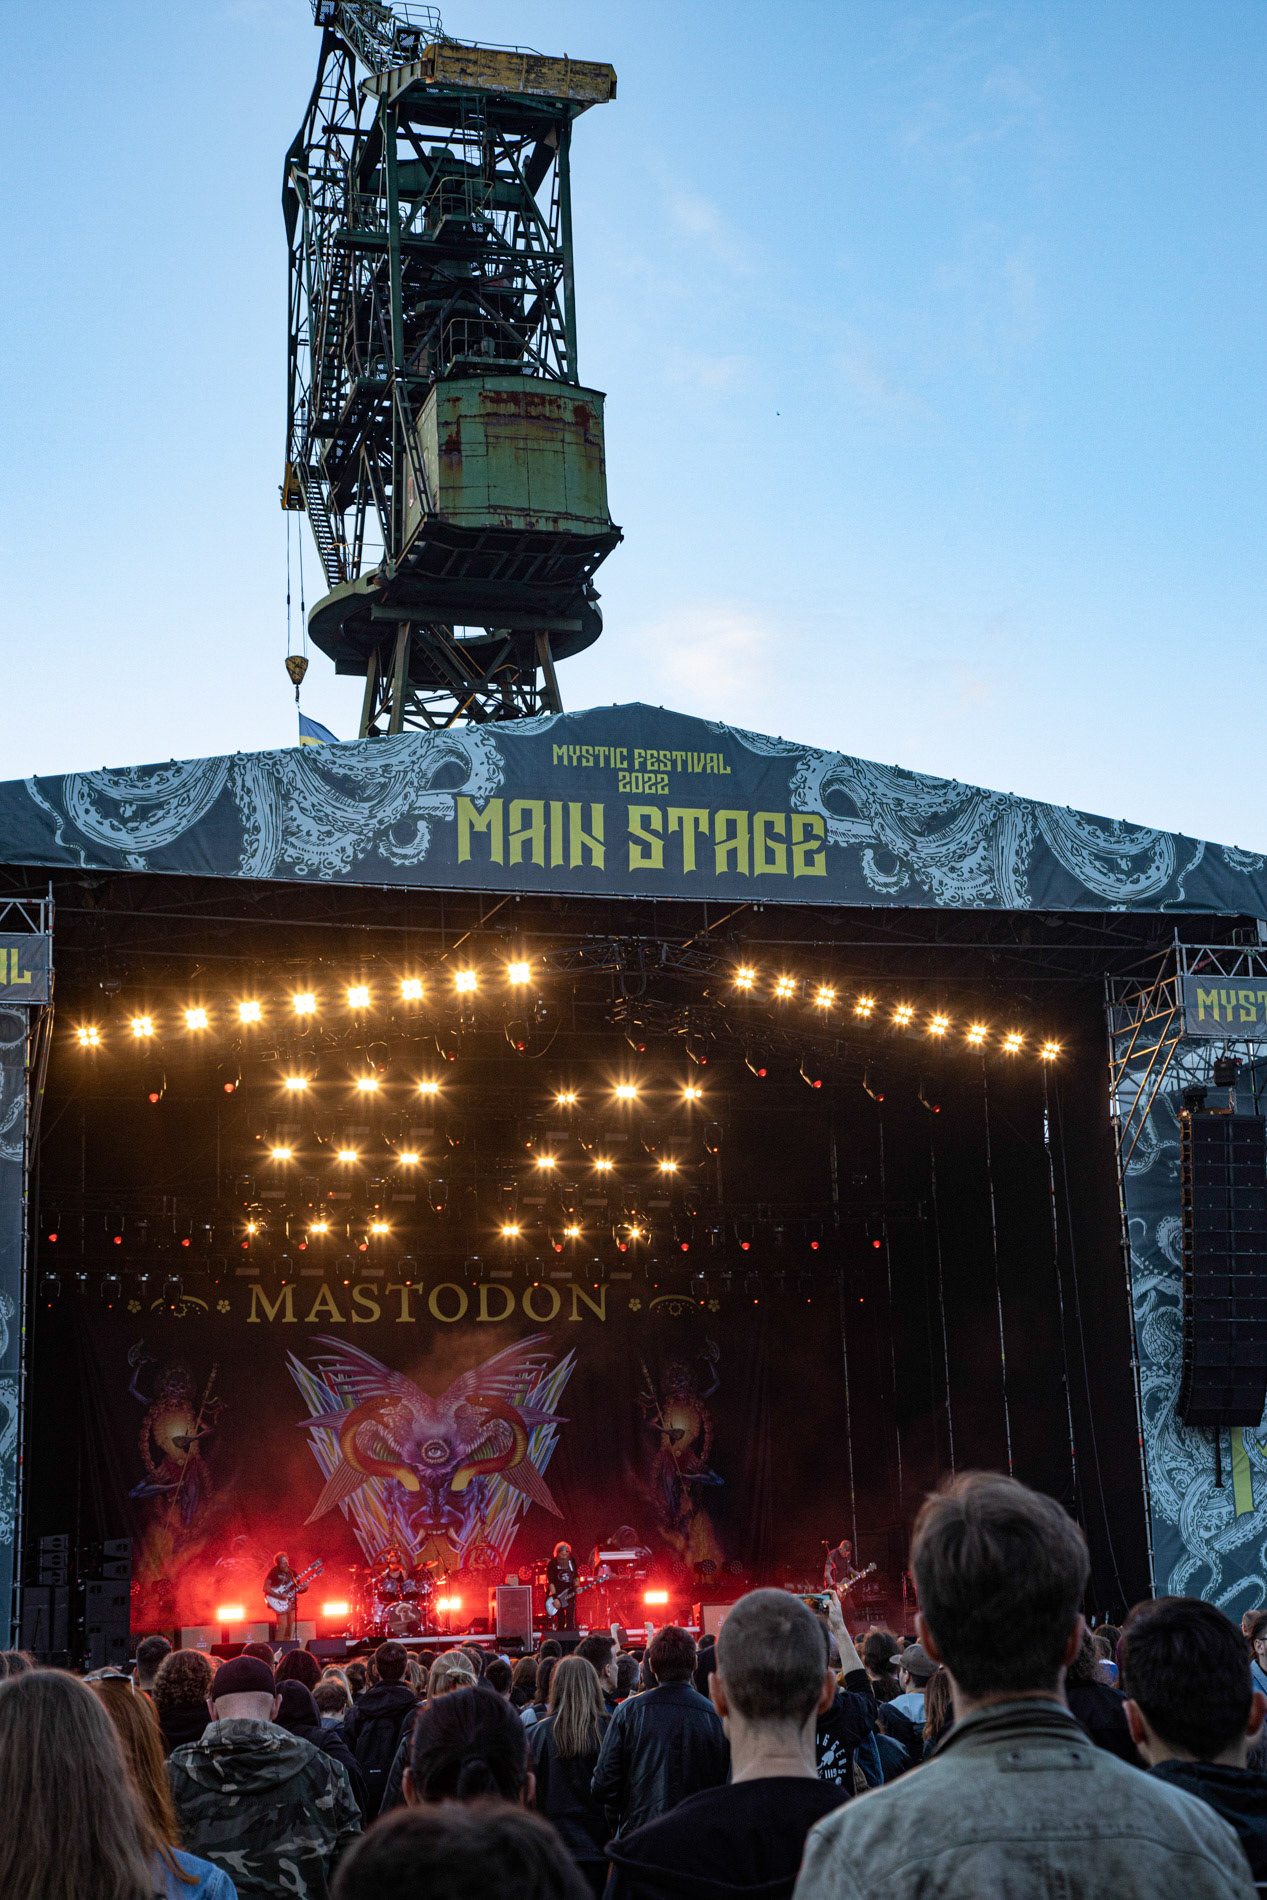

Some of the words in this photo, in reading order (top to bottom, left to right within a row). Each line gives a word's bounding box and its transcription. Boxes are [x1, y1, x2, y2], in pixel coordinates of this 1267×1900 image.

[552, 744, 628, 768] MYSTIC
[634, 749, 732, 774] FESTIVAL
[618, 771, 670, 795] 2022
[456, 796, 607, 872] MAIN
[627, 804, 828, 880] STAGE
[246, 1283, 610, 1323] MASTODON
